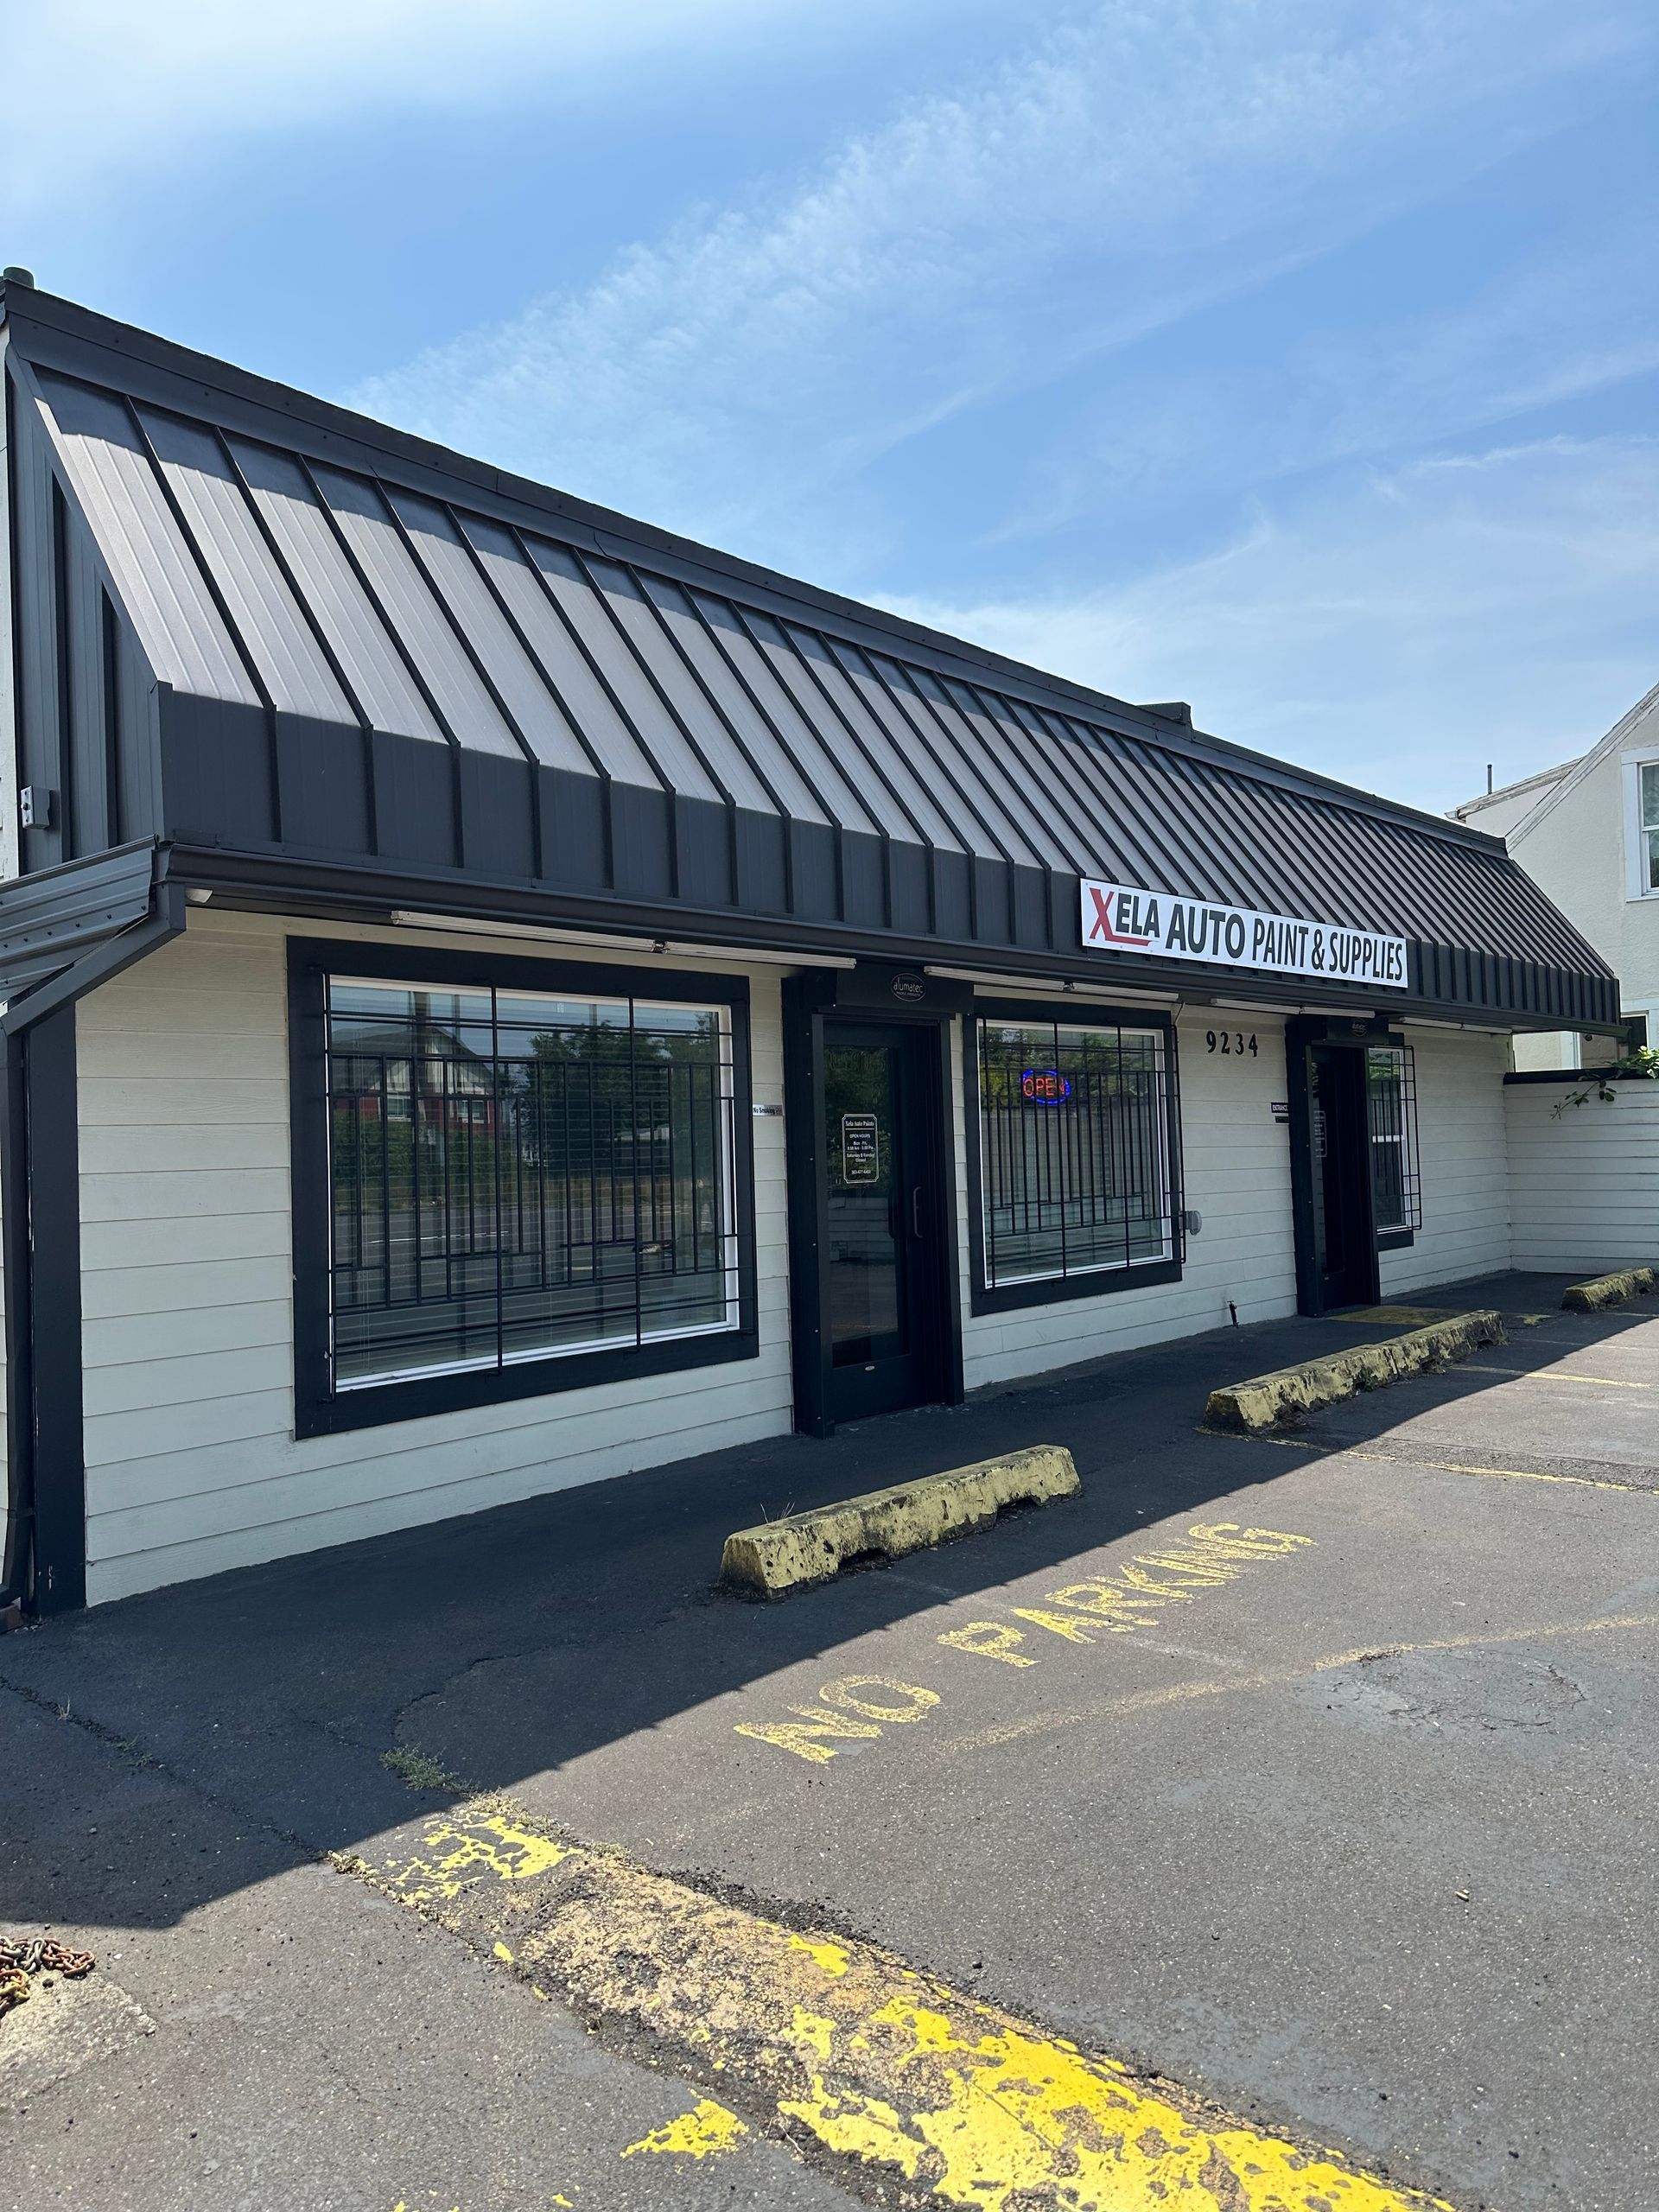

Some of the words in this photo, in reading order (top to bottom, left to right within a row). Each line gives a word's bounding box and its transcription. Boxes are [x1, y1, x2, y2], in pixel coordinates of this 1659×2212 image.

[1090, 887, 1160, 946] XELA
[1166, 904, 1245, 958] AUTO
[1252, 918, 1308, 968] PAINT
[1311, 929, 1325, 969] &
[1329, 932, 1402, 981] SUPPLIES
[893, 976, 924, 994] alumatec
[1206, 1030, 1258, 1057] 9234
[1023, 1077, 1065, 1097] OPEN
[734, 1675, 940, 1764] NO
[937, 1522, 1316, 1667] PARKING
